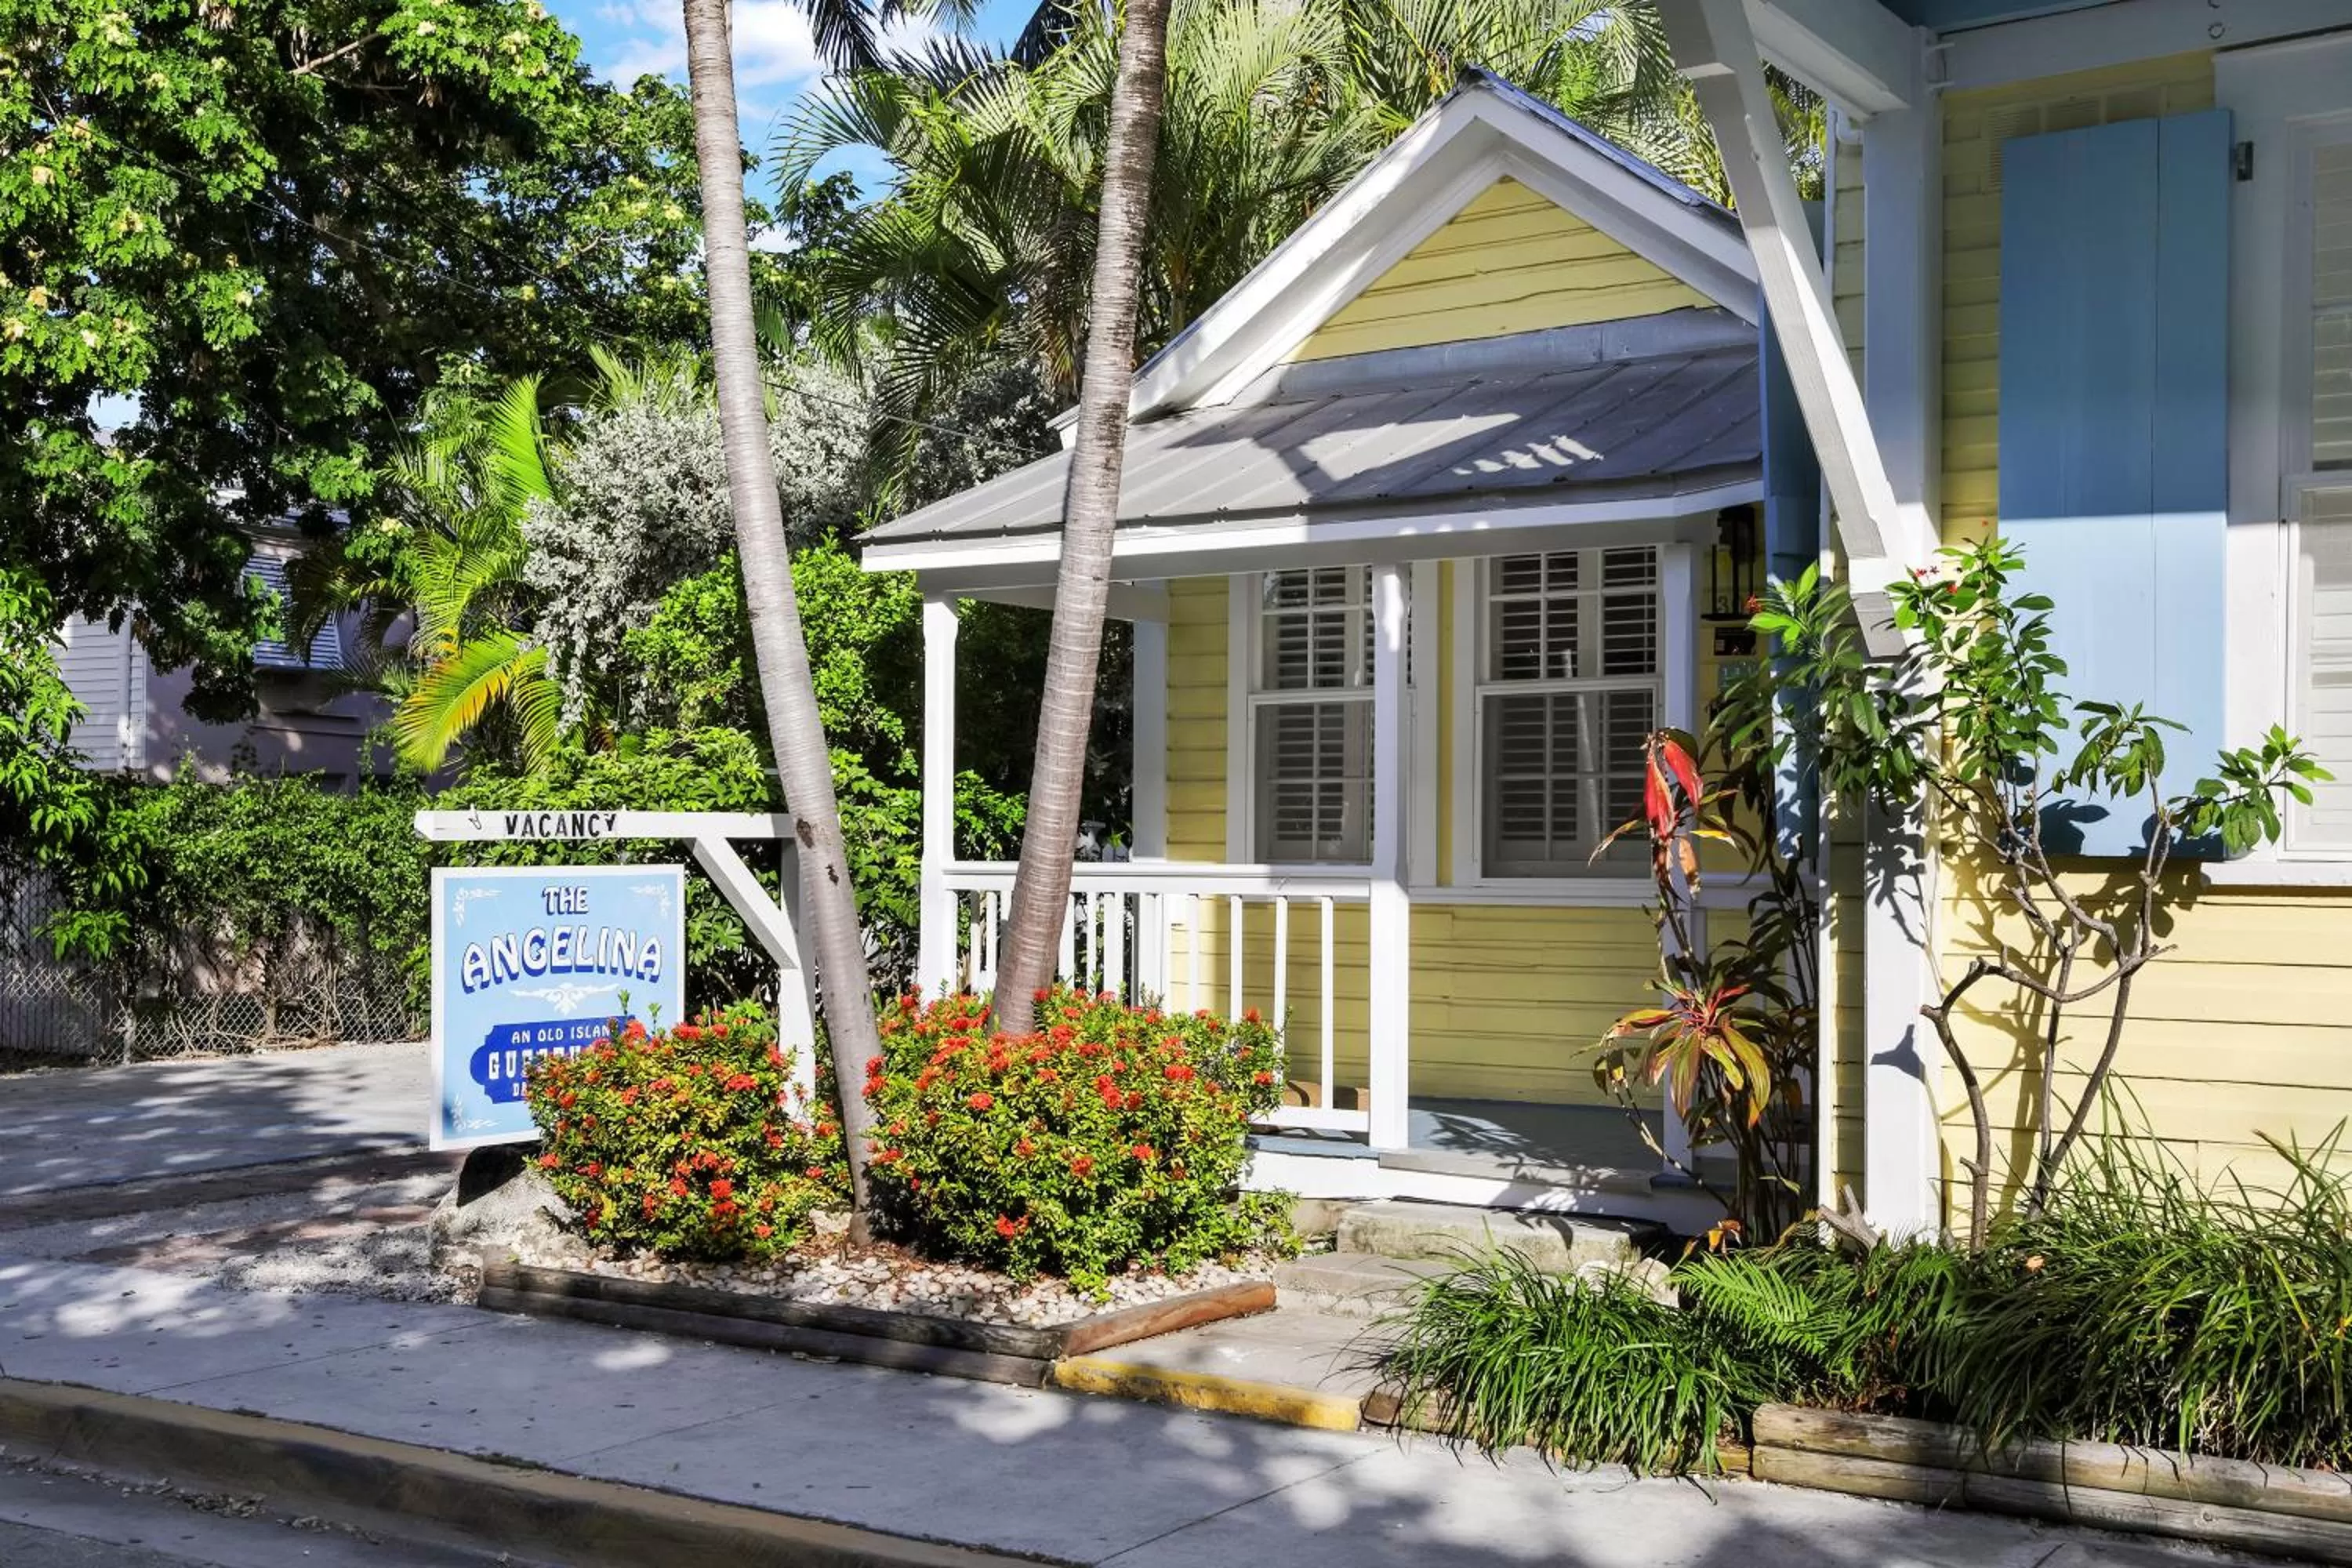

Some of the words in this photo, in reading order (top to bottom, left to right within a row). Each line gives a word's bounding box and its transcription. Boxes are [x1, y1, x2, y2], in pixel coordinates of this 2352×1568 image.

[504, 813, 618, 837] VACANCY
[542, 886, 589, 916] THE
[461, 925, 662, 994] ANGELINA
[511, 1030, 531, 1044] AN
[537, 1028, 564, 1042] OLD
[570, 1025, 610, 1039] ISLAN
